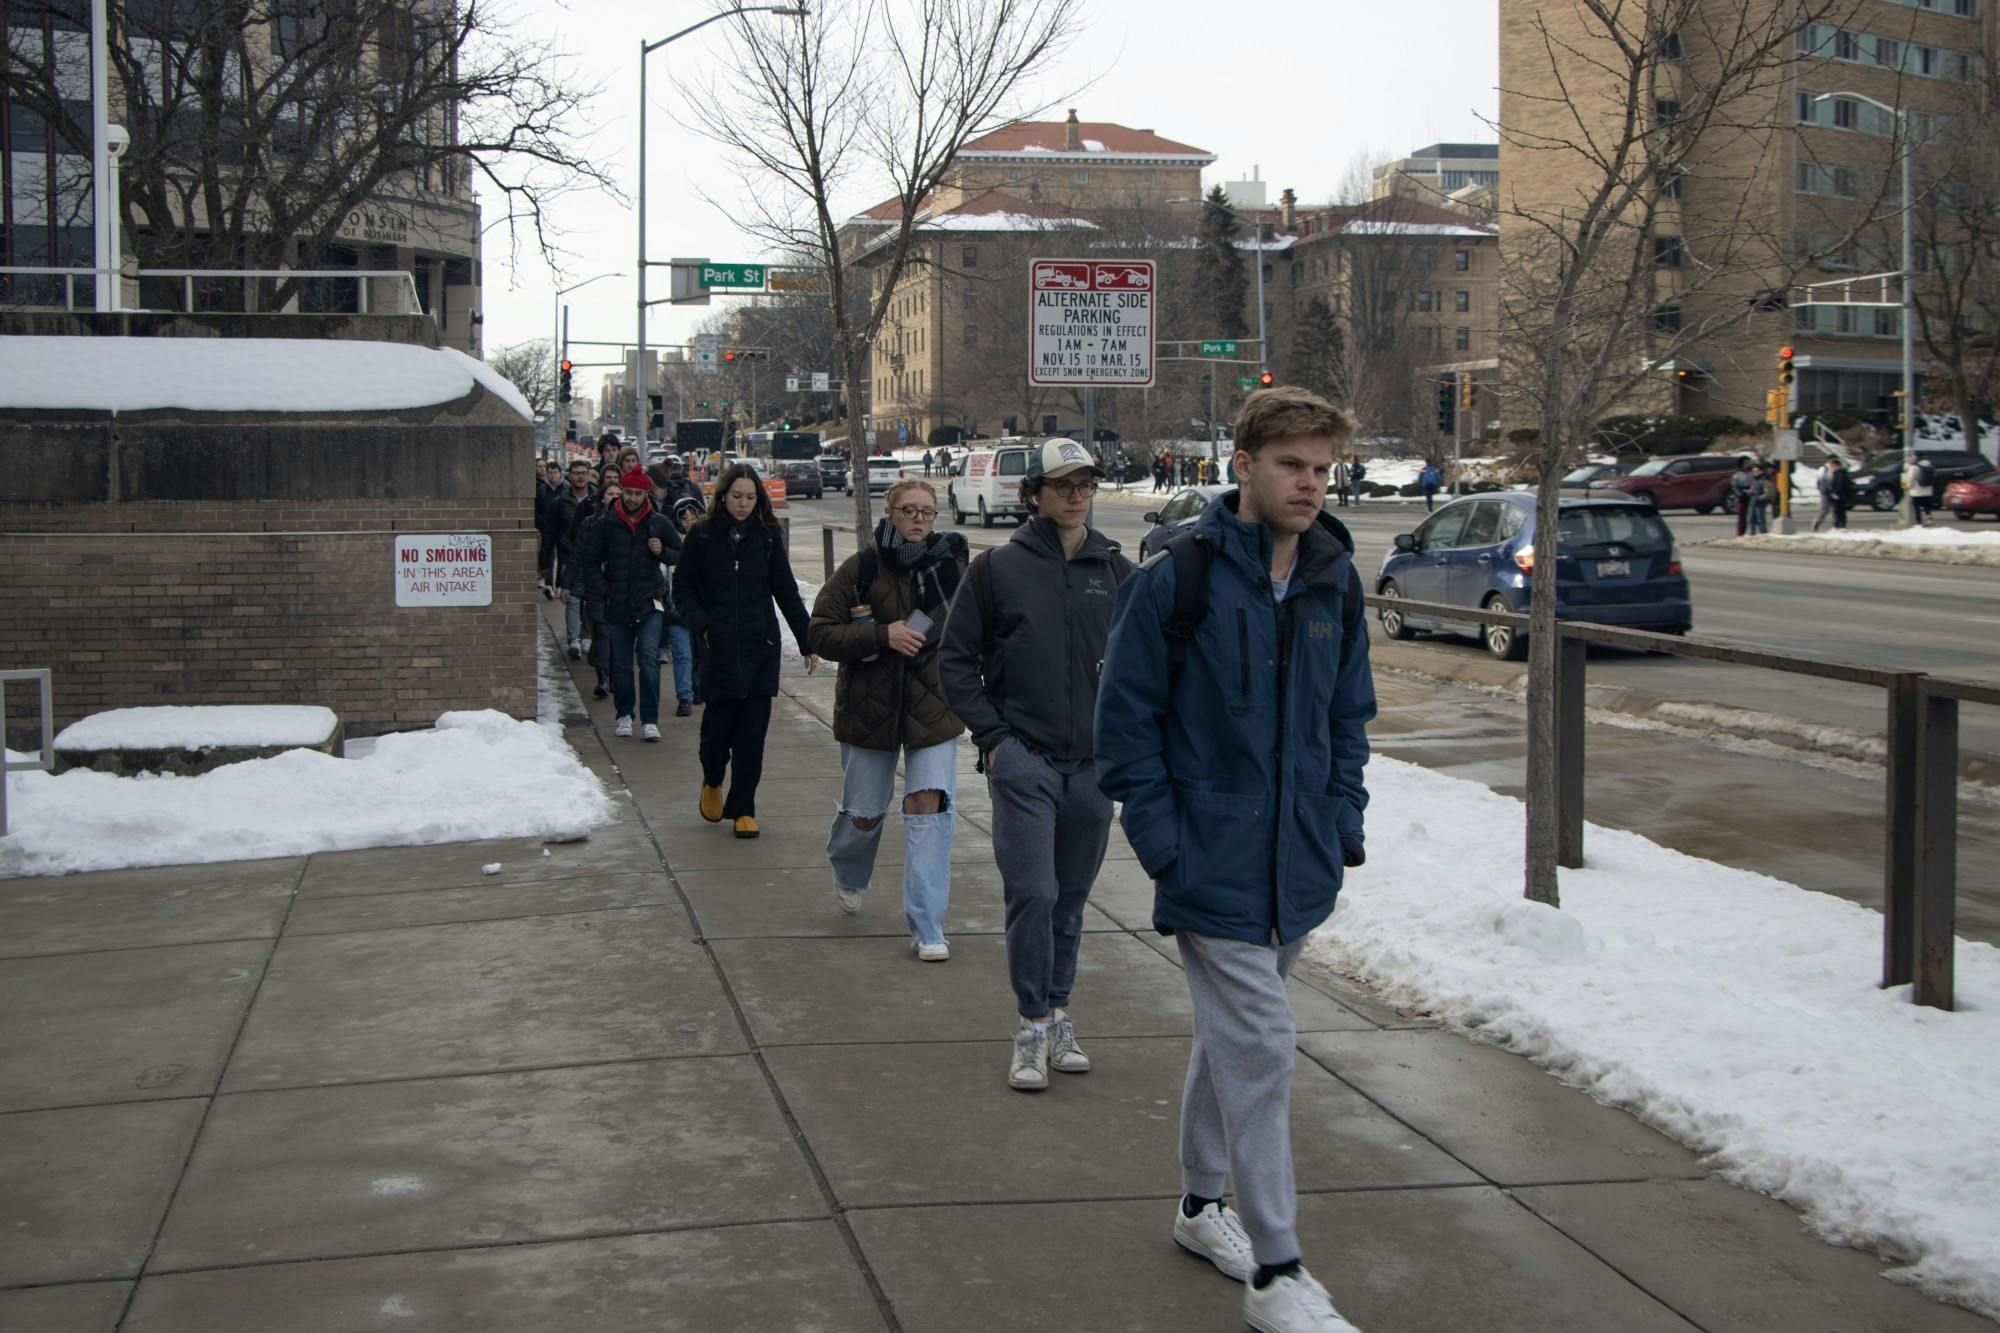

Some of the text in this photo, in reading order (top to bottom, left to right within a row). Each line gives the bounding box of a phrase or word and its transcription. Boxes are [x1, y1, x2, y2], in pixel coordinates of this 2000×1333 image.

[704, 268, 760, 283] Park St
[1038, 292, 1148, 308] ALTERNATE SIDE
[1064, 309, 1121, 324] PARKING
[1039, 324, 1147, 337] REGULATIONS IN EFFECT
[1203, 343, 1235, 353] Park St
[1086, 355, 1096, 365] TO
[1035, 367, 1149, 378] EXCEPT SNOW EMERGENCY ZONE
[401, 548, 488, 562] NO SMOKING
[403, 567, 485, 579] IN THIS AREA
[410, 581, 477, 592] AIR INTAKE
